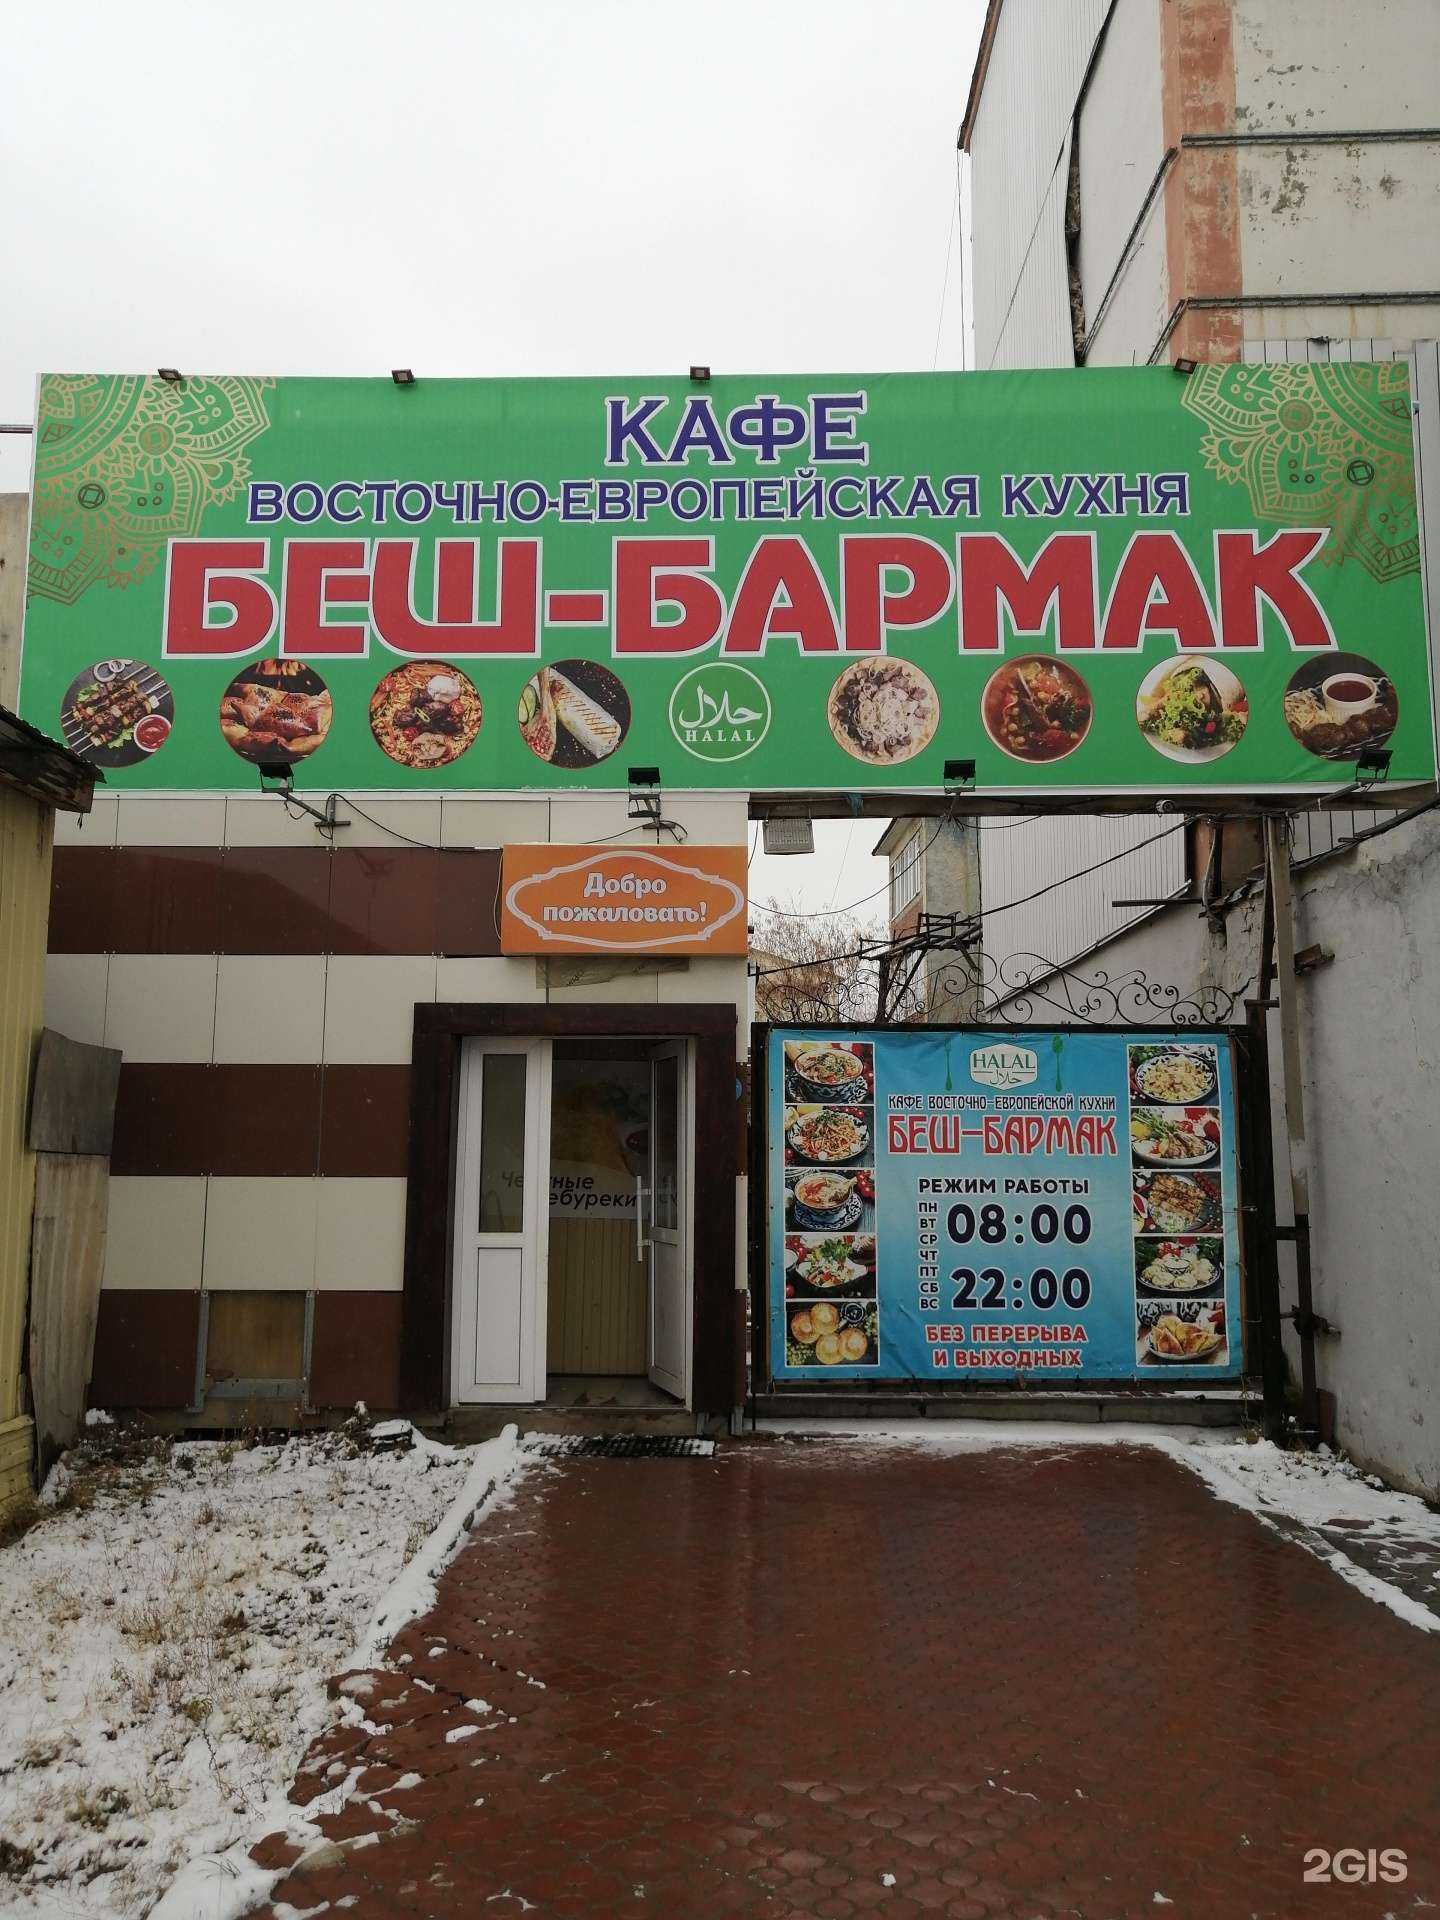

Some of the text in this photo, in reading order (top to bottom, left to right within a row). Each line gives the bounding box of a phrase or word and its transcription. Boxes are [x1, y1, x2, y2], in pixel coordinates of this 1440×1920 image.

[605, 391, 868, 466] КАФЕ
[247, 469, 1190, 525] ВОСТОЧНО-ЕВРОПЕЙСКАЯ КУХНЯ
[162, 528, 1338, 659] БЕШ-БАРМАК
[679, 684, 763, 728] حلال
[685, 729, 756, 742] HALAL
[583, 872, 667, 900] Добро
[543, 902, 707, 922] пожаловать!
[972, 1053, 1036, 1069] HALAL
[989, 1069, 1022, 1085] حلال
[889, 1094, 1115, 1111] КАФЕ ВОСТОЧНО-ЕВРОПЕЙСКОЙ КУХНИ
[889, 1115, 1117, 1155] БЕШ-БАРМАК
[919, 1178, 1089, 1194] РЕЖИМ РАБОТЫ
[919, 1202, 937, 1213] ПН
[920, 1218, 936, 1229] ВТ
[947, 1203, 1091, 1244] 08:00
[919, 1234, 937, 1245] СР
[919, 1250, 937, 1261] ЧТ
[919, 1266, 938, 1278] ПТ
[920, 1282, 938, 1293] СБ
[951, 1268, 1091, 1309] 22:00
[920, 1298, 938, 1310] ВС
[926, 1326, 1088, 1342] БЕЗ ПЕРЕРЫВА
[934, 1350, 1083, 1369] И ВЫХОДНЫХ
